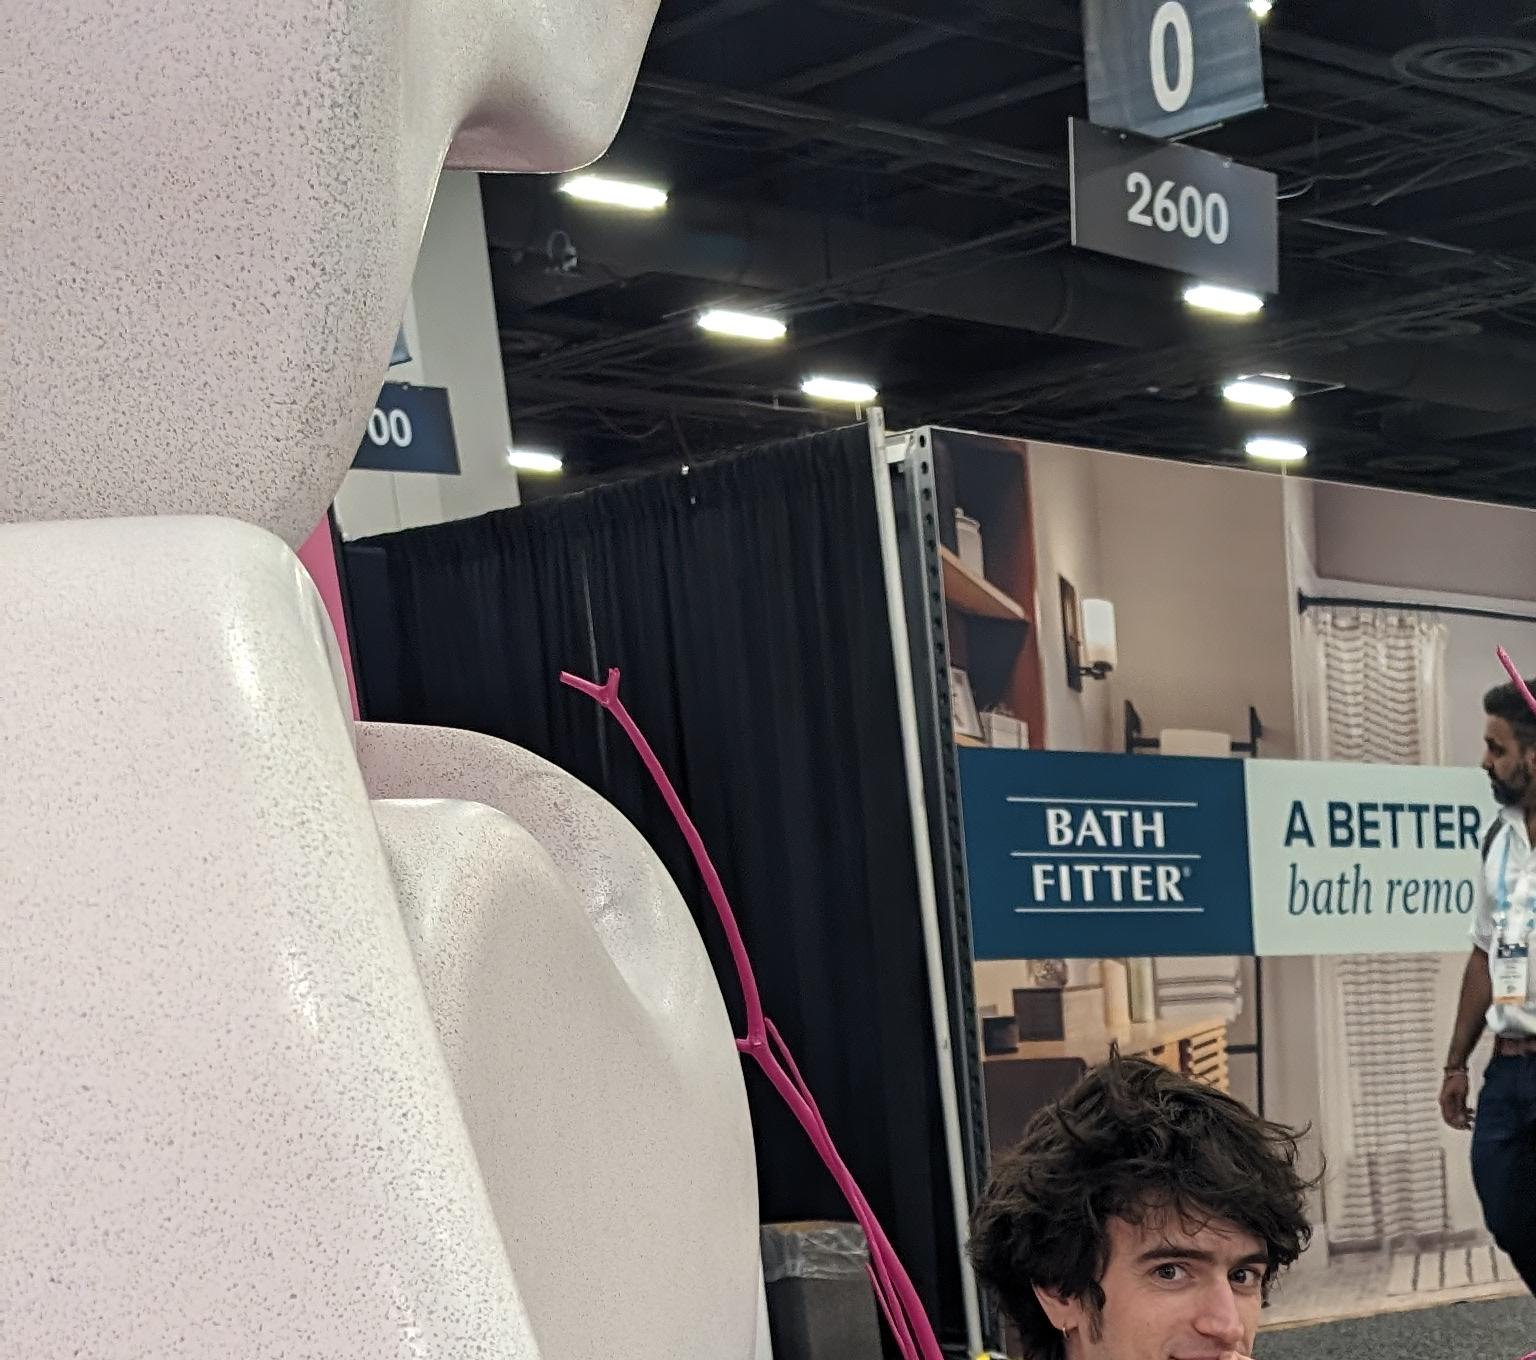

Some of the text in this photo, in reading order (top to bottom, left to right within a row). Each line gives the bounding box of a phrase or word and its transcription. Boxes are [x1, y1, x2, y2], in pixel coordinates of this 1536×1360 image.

[1150, 1, 1194, 112] 0
[1126, 171, 1230, 245] 2600
[1045, 808, 1166, 848] BATH
[1284, 800, 1481, 850] A BETTER
[1288, 863, 1474, 916] bath remo
